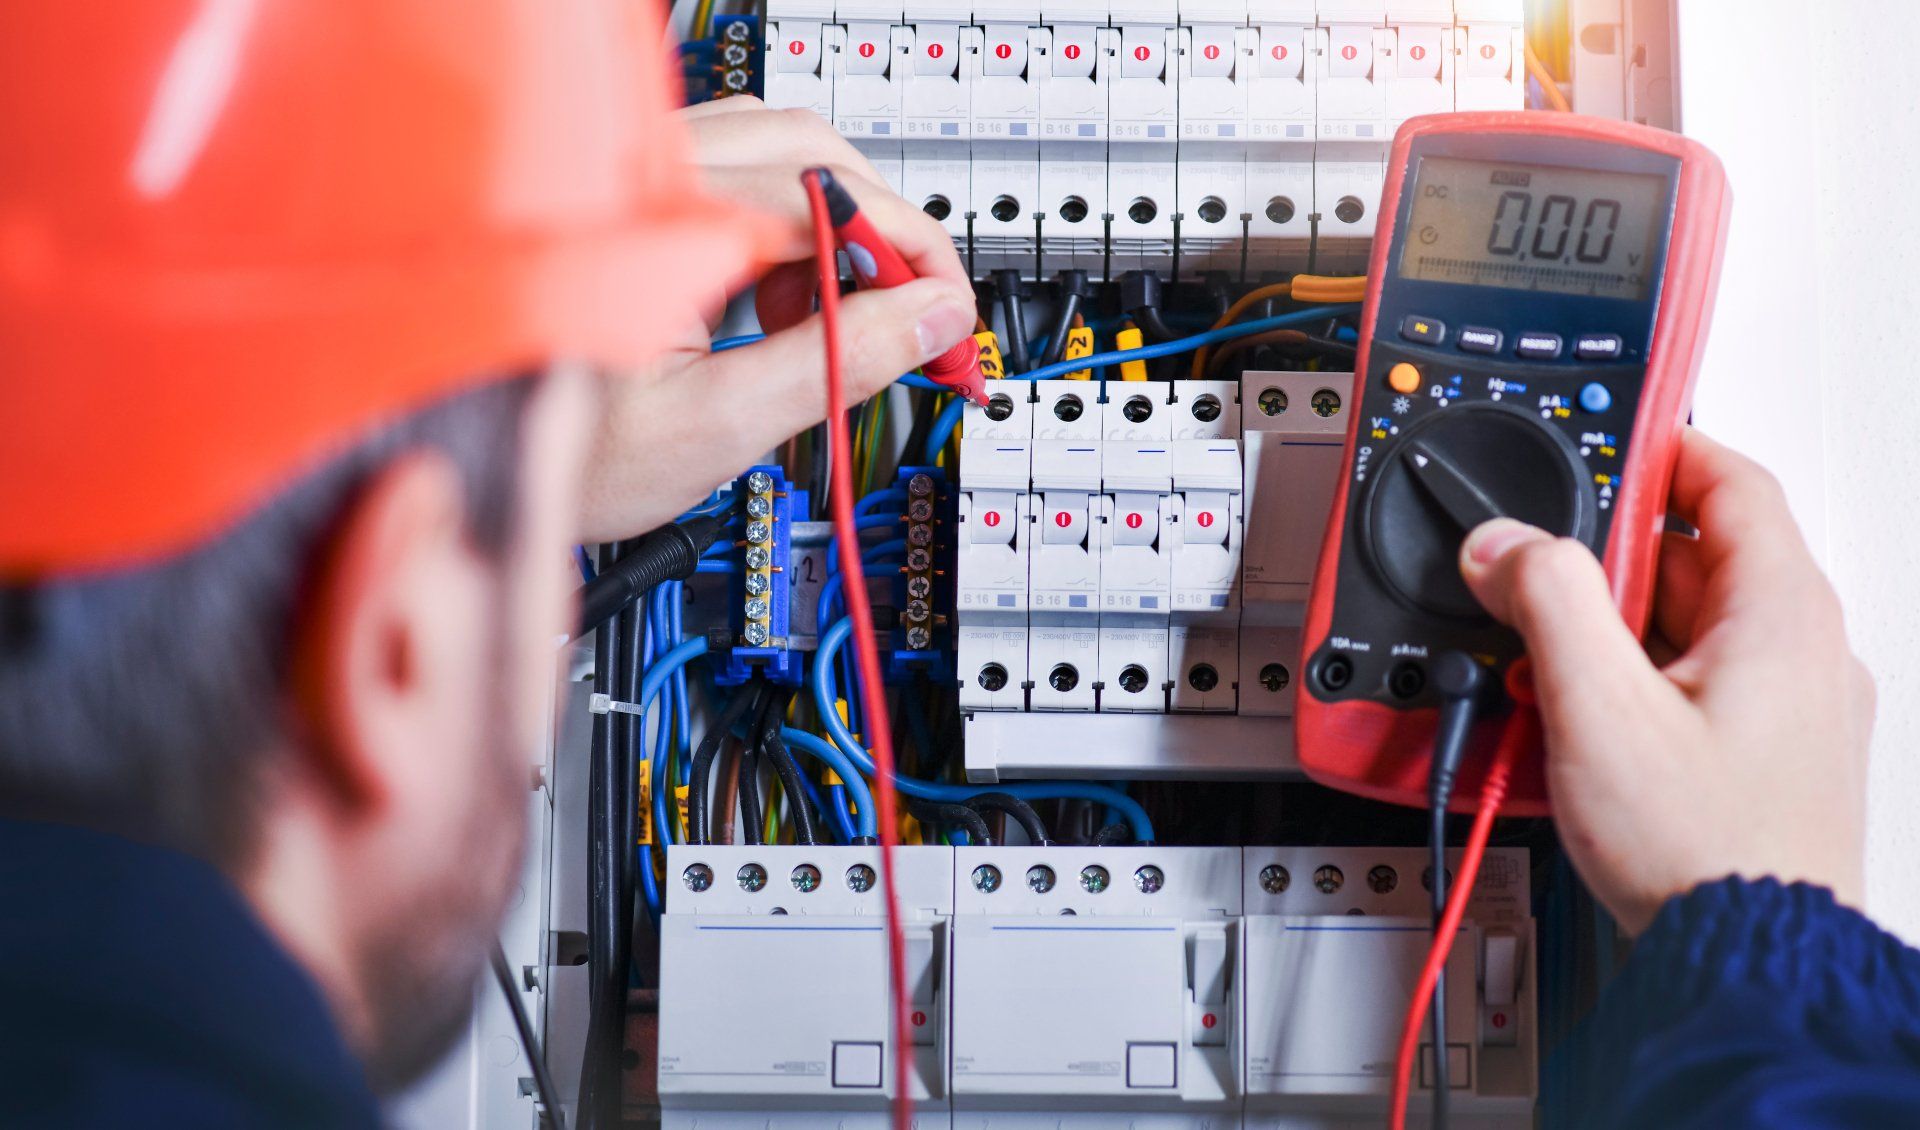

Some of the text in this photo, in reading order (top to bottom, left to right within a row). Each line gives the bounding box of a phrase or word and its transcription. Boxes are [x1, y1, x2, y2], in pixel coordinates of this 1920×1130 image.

[850, 122, 864, 131] 16
[920, 123, 933, 132] 16
[989, 123, 1002, 132] 16
[1058, 124, 1071, 134] 16
[1127, 125, 1140, 135] 16
[1197, 125, 1210, 134] 16
[1424, 184, 1448, 199] DC
[1627, 252, 1641, 266] V
[963, 594, 989, 604] B 16
[1036, 595, 1061, 605] B 16
[1107, 595, 1132, 605] B 16
[1177, 594, 1202, 604] B 16
